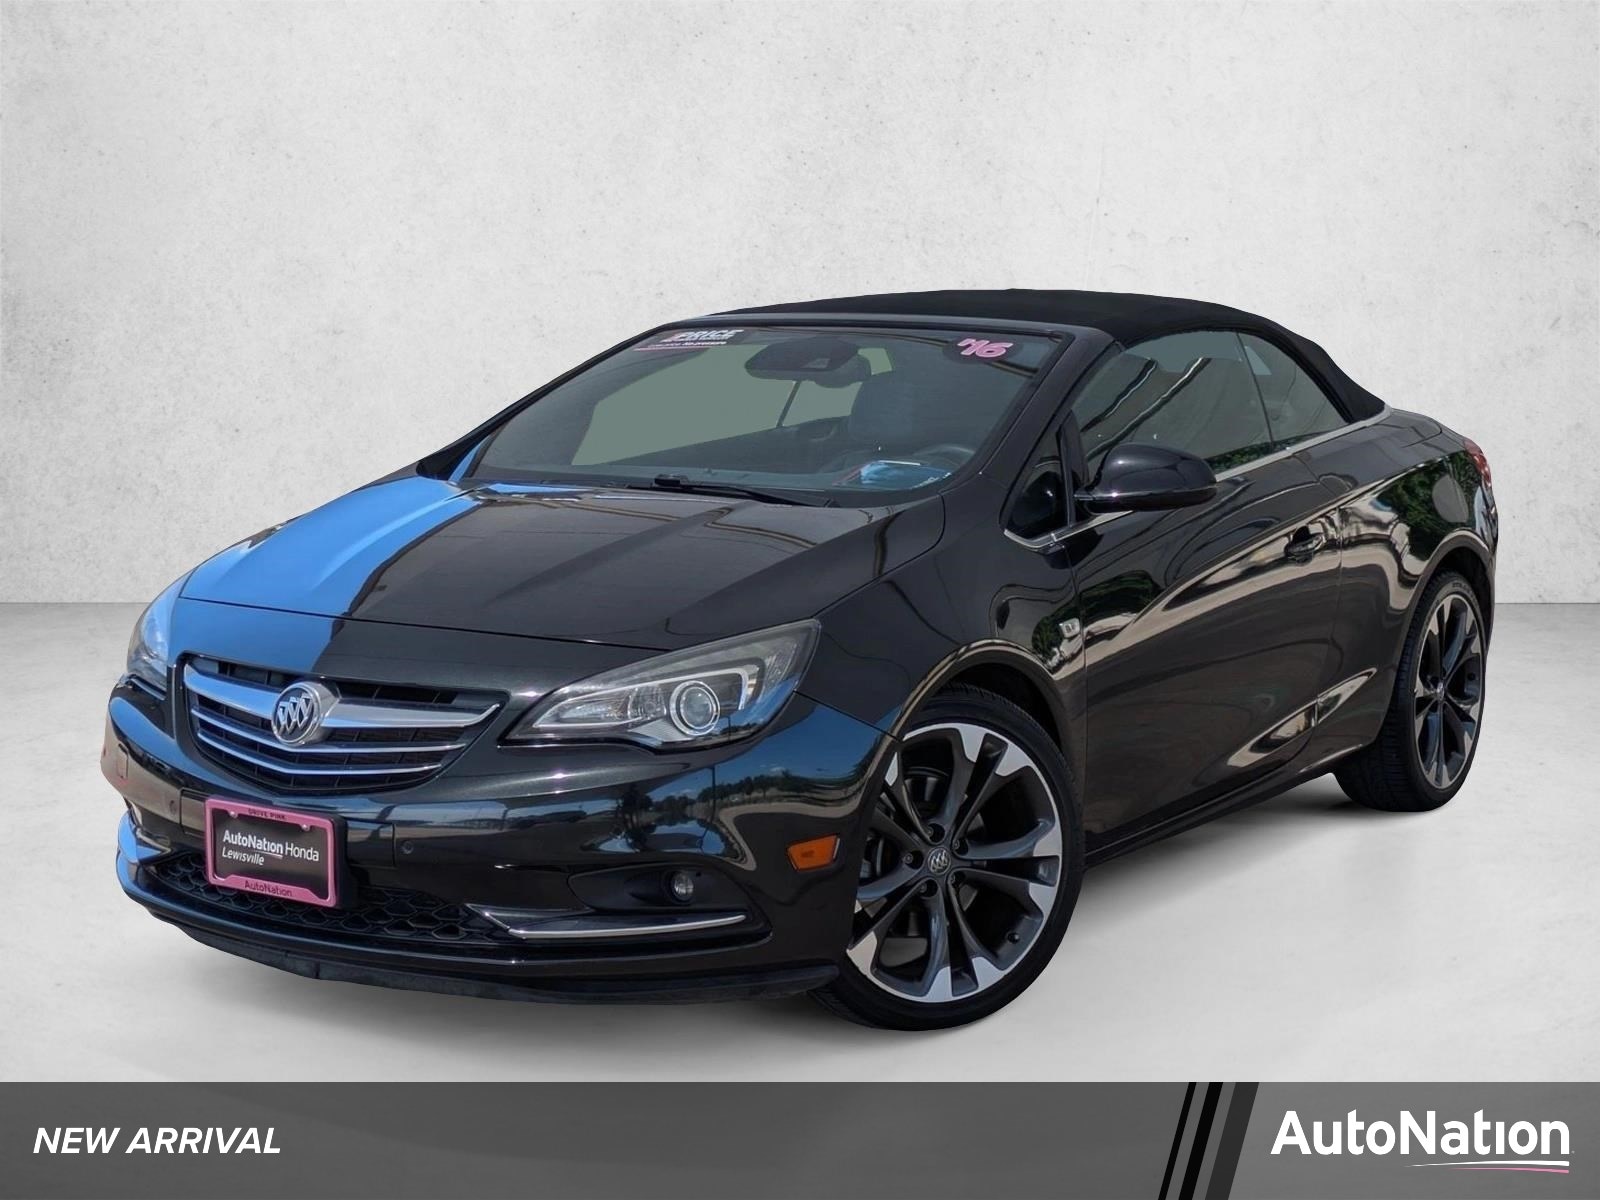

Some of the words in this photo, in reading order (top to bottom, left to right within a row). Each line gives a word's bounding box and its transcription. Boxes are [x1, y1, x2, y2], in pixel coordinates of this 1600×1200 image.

[223, 829, 283, 854] AutoNation
[284, 841, 320, 862] Honda
[222, 846, 265, 866] Lewisville
[244, 880, 293, 897] AutoNation
